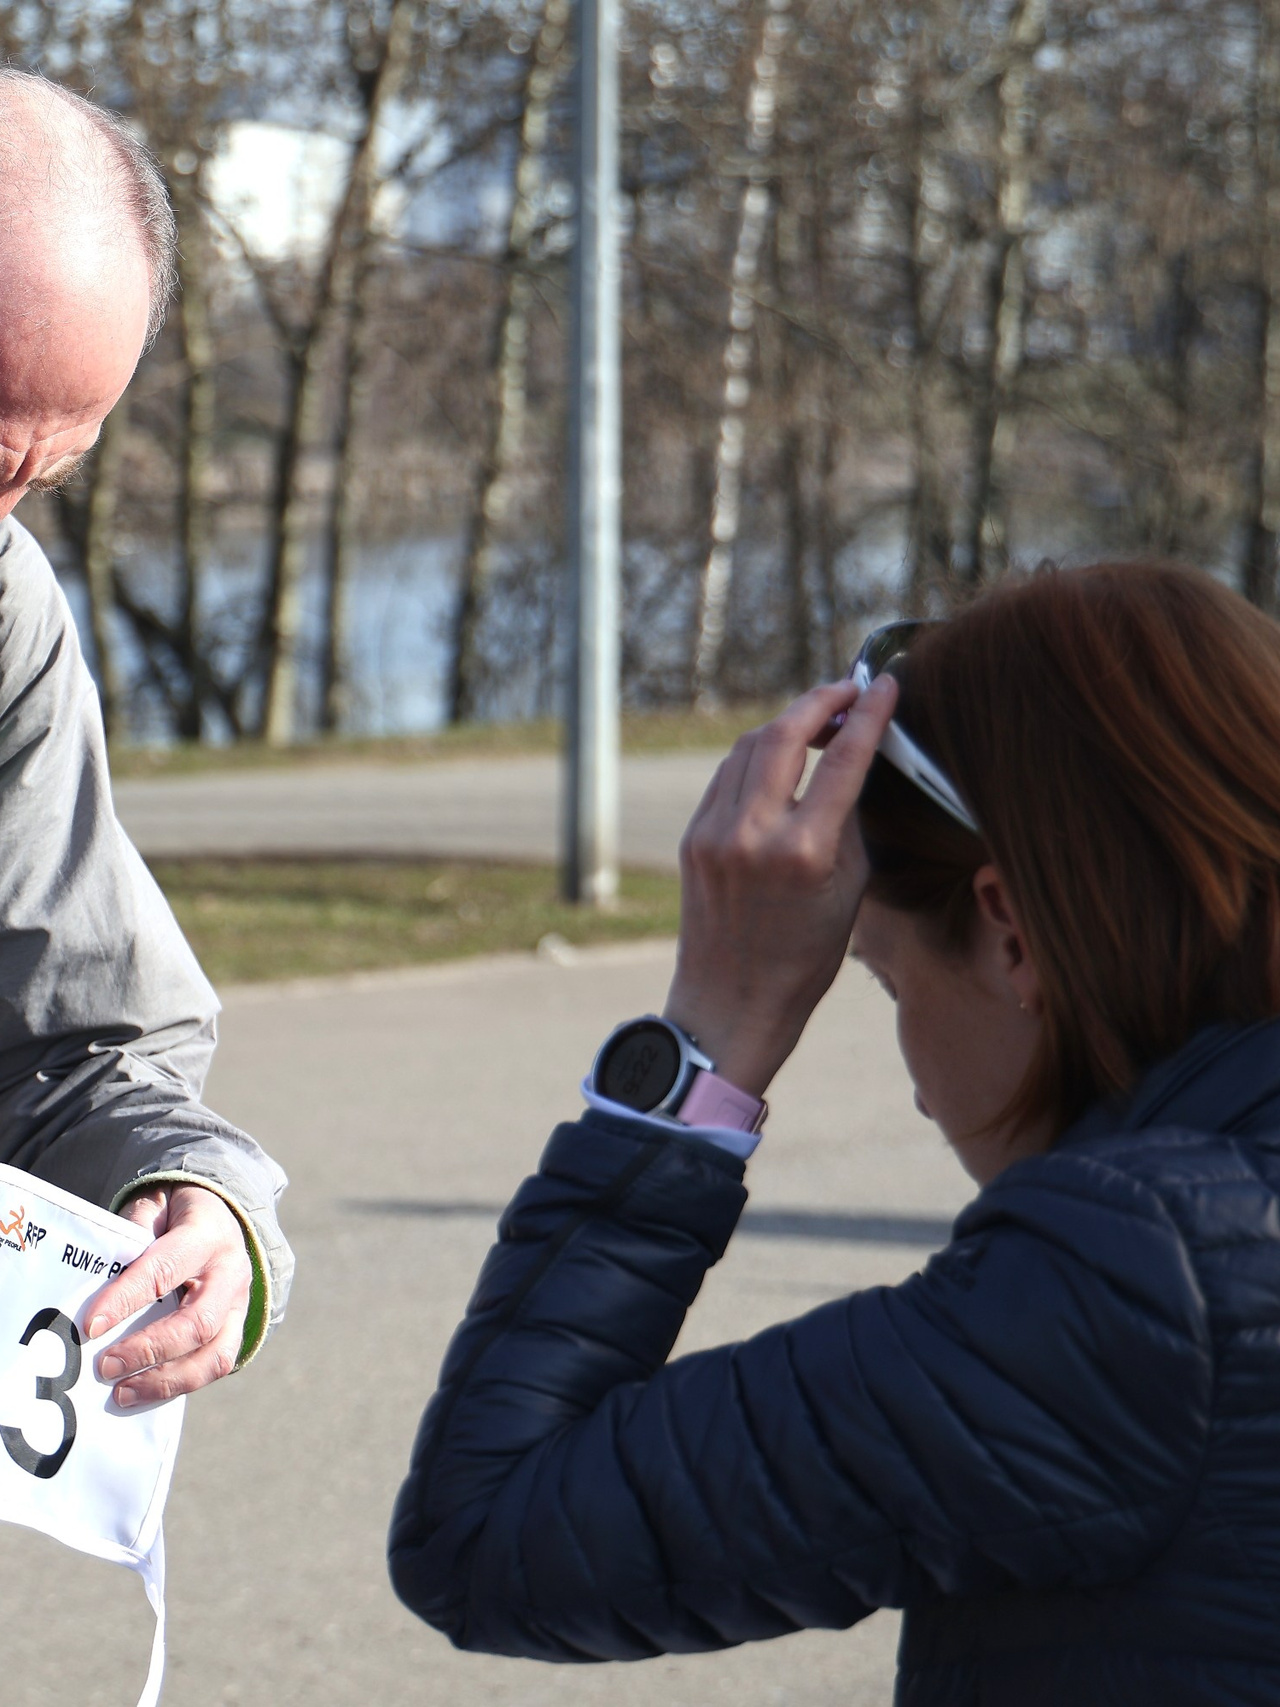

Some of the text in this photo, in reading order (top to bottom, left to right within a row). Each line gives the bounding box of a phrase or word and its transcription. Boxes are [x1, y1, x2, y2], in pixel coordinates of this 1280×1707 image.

[23, 1221, 47, 1249] RFP
[61, 1243, 94, 1272] RUN
[90, 1256, 109, 1275] for
